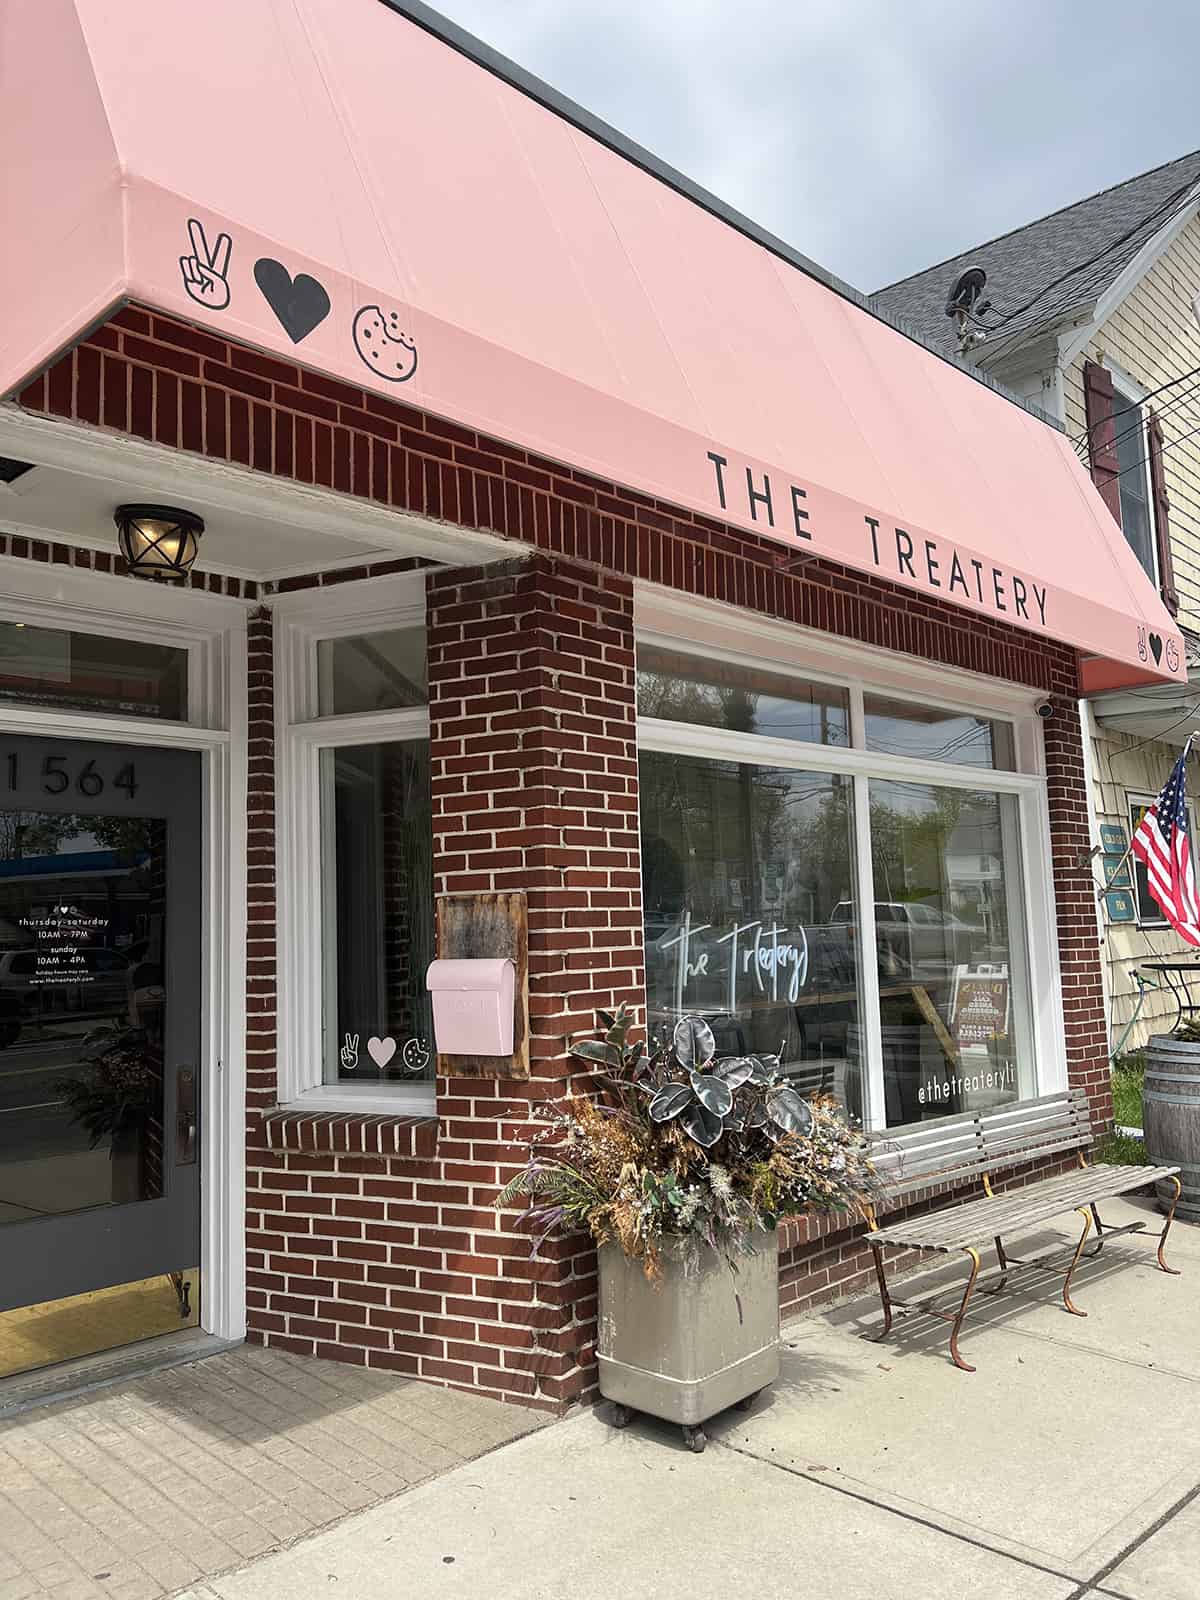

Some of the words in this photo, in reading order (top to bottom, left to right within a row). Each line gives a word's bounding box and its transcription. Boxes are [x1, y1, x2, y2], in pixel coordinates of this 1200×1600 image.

[707, 450, 812, 541] THE
[863, 515, 1047, 626] TREATERY
[7, 752, 139, 799] 1564
[19, 917, 109, 927] thursday-saturday
[38, 930, 61, 939] 10AM
[70, 930, 88, 938] 7PM
[51, 946, 77, 954] sunday
[37, 956, 60, 965] 10AM
[918, 1060, 1016, 1104] @thetreateryli
